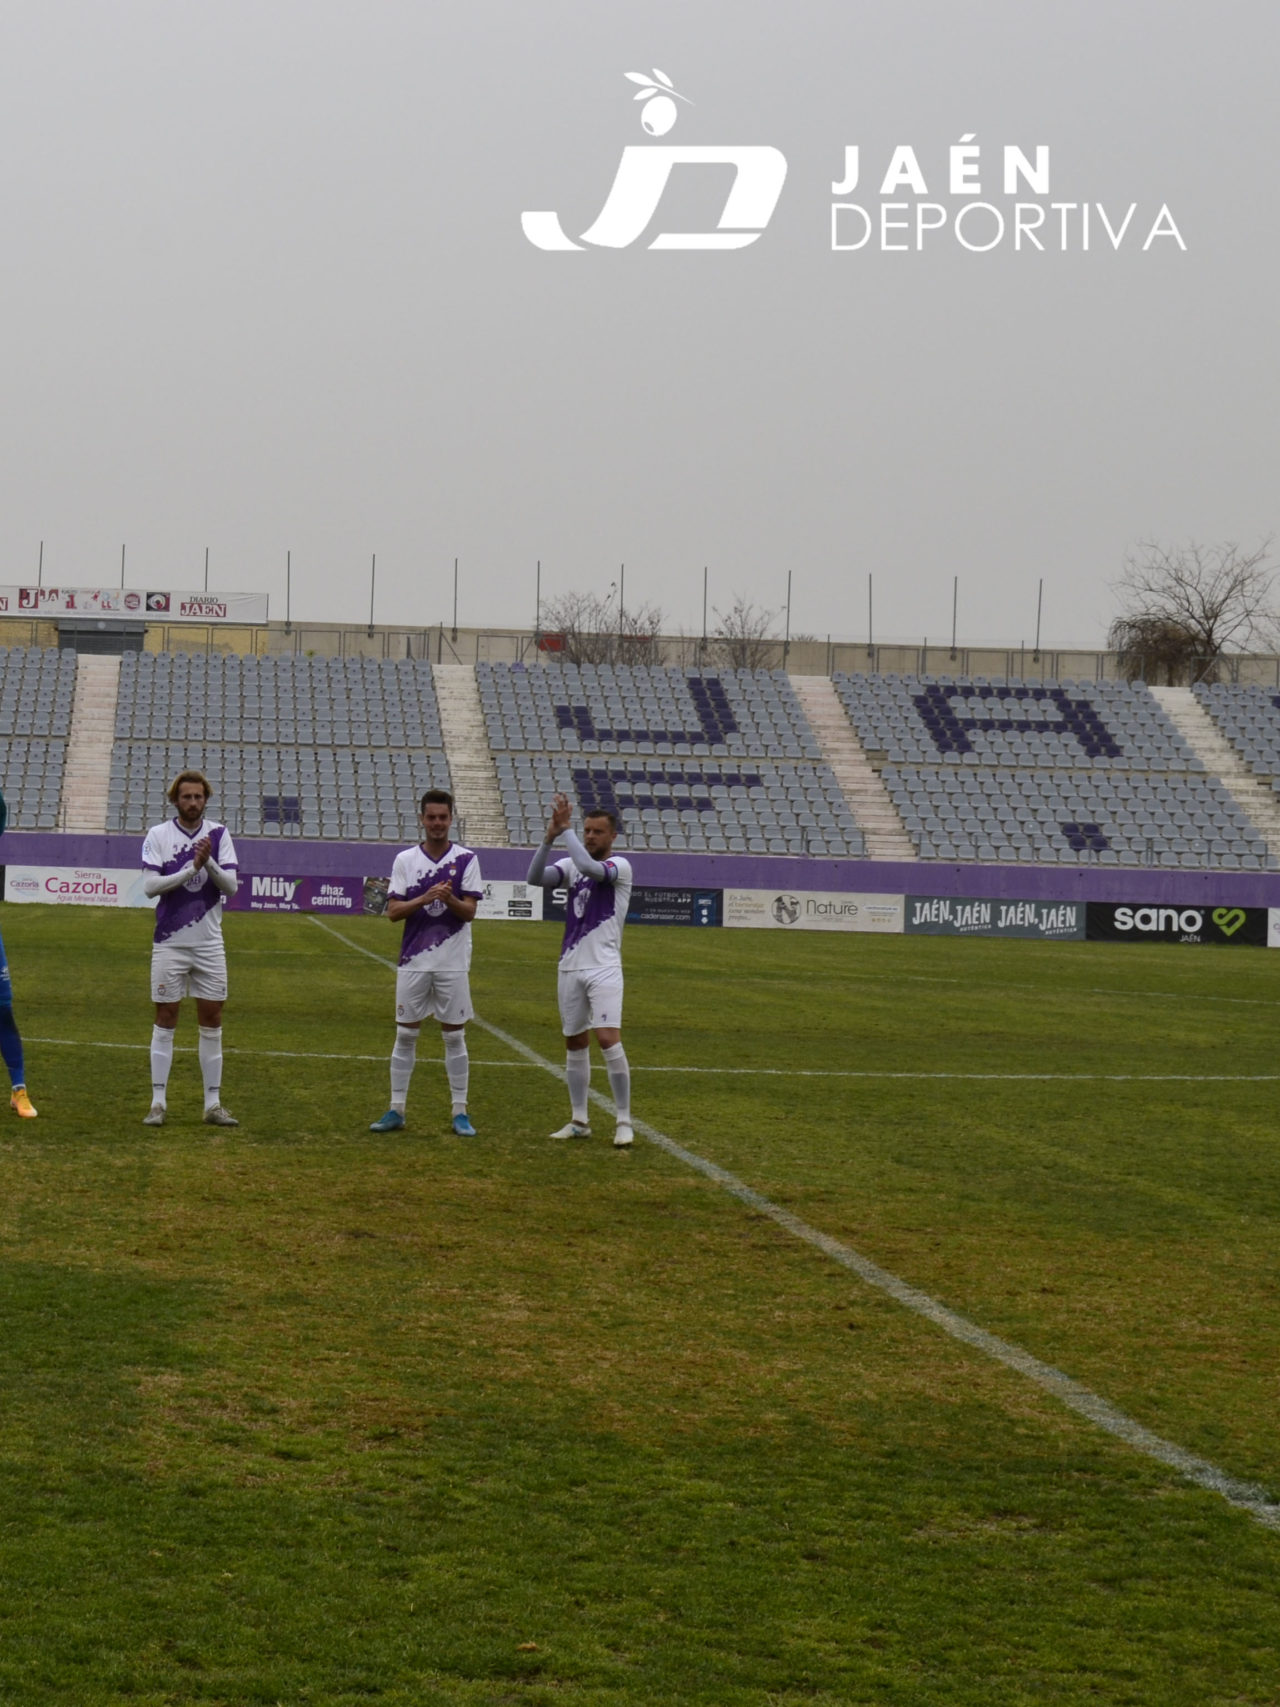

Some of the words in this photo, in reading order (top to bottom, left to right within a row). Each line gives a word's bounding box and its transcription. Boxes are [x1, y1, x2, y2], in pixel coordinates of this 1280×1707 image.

[189, 596, 219, 604] DIARIO
[74, 870, 102, 880] Sierra
[45, 877, 117, 895] Cazorla
[320, 884, 345, 897] #haz
[311, 895, 352, 909] centring
[912, 898, 954, 925] JAÉN,
[953, 902, 991, 927] JAÉN
[997, 901, 1039, 928] JAÉN,
[1038, 904, 1077, 931] JAÉN
[1113, 906, 1203, 933] sano
